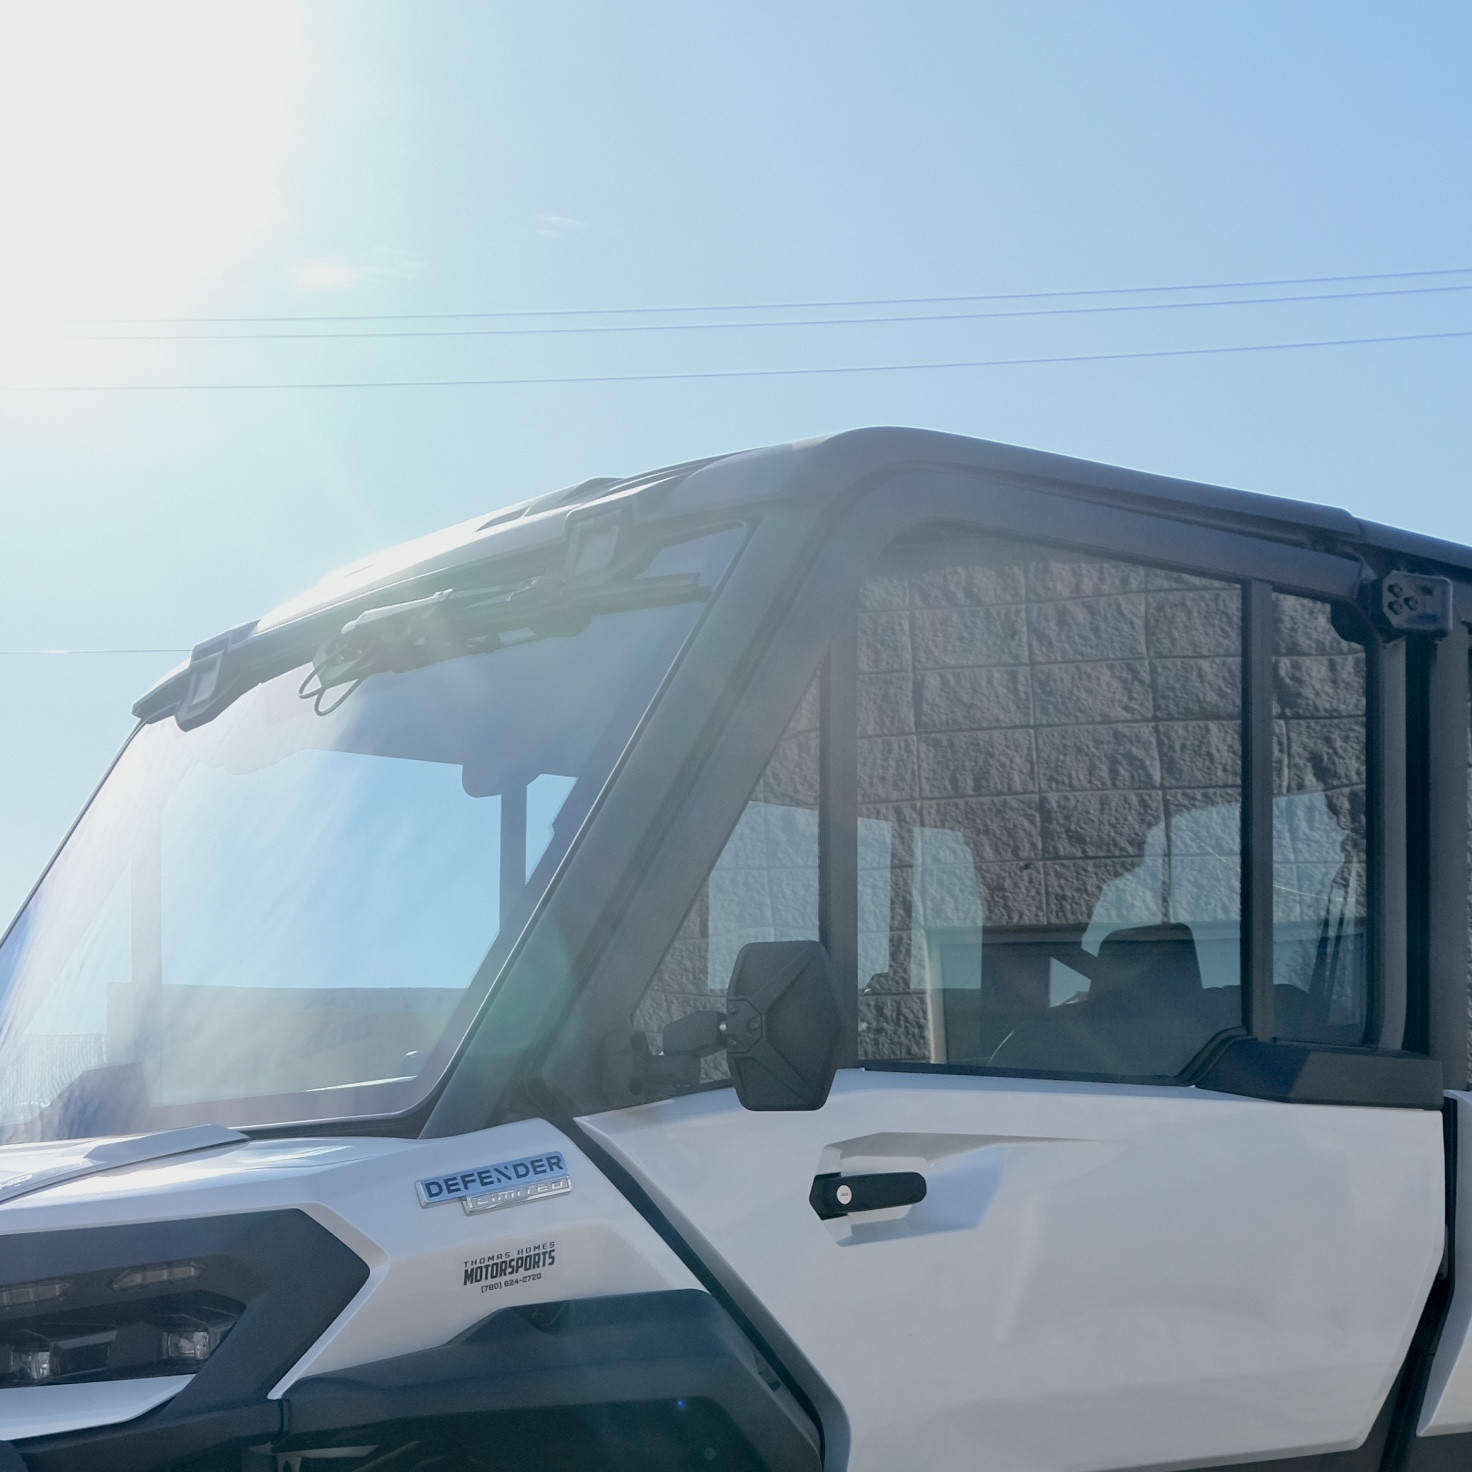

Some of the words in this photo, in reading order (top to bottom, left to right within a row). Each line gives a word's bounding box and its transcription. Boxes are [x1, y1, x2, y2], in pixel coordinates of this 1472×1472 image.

[425, 1155, 564, 1198] DEFENDER
[463, 1249, 556, 1286] MOTORSPORTS
[464, 1251, 511, 1268] THOMAS
[517, 1241, 555, 1256] HOMES
